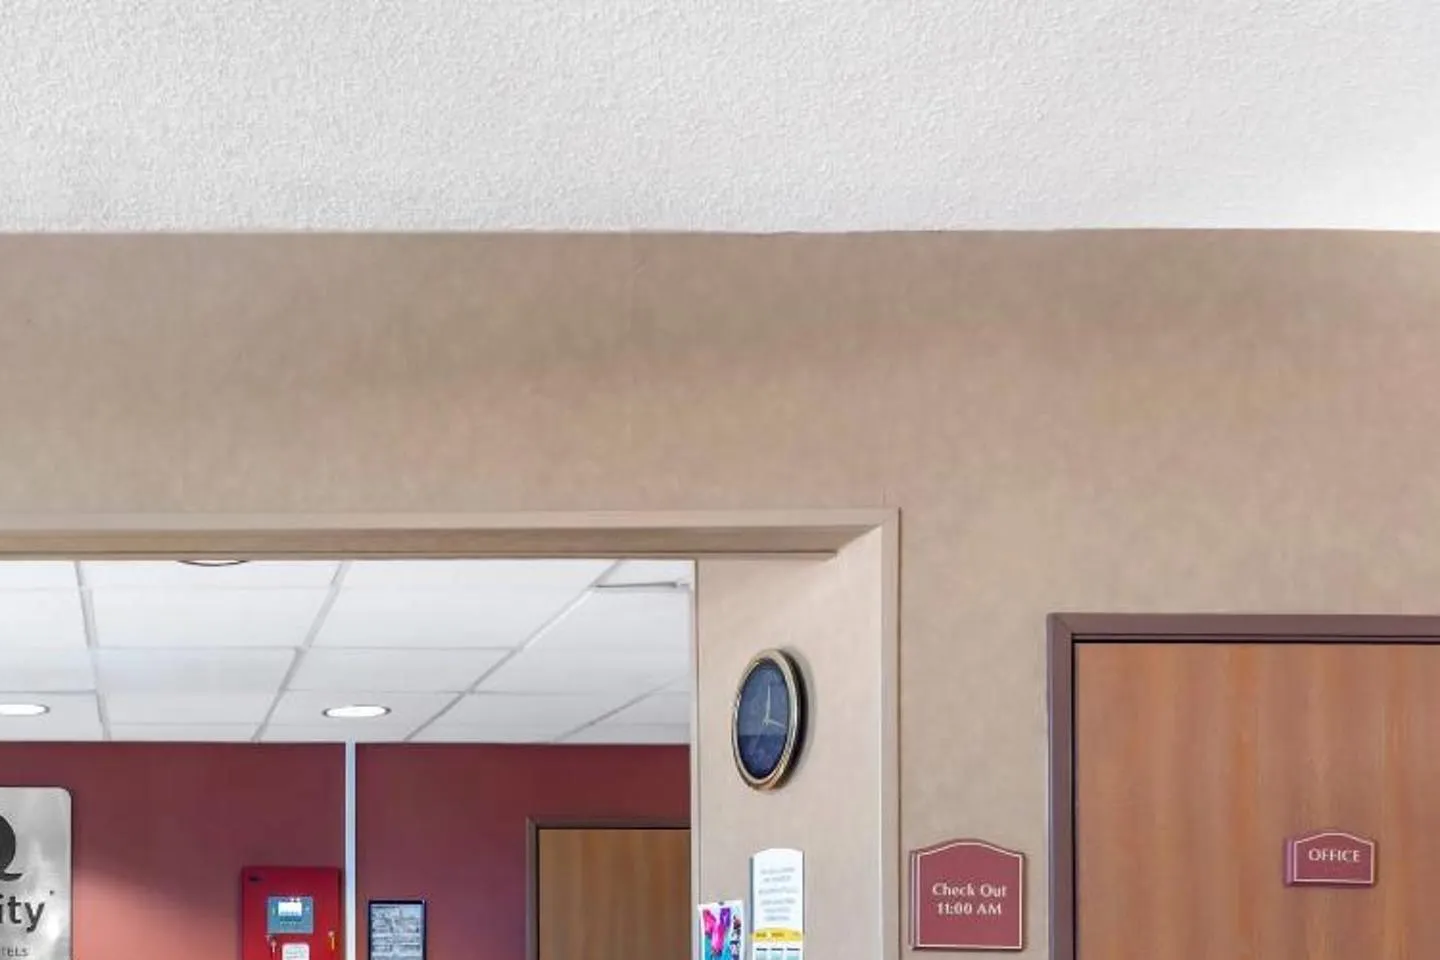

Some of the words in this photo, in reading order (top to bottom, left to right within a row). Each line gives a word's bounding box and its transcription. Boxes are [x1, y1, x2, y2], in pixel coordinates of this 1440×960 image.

[1308, 848, 1361, 863] OFFICE
[932, 882, 975, 897] Check
[980, 883, 1007, 898] Out
[937, 902, 973, 915] 11:00
[976, 903, 1002, 916] AM
